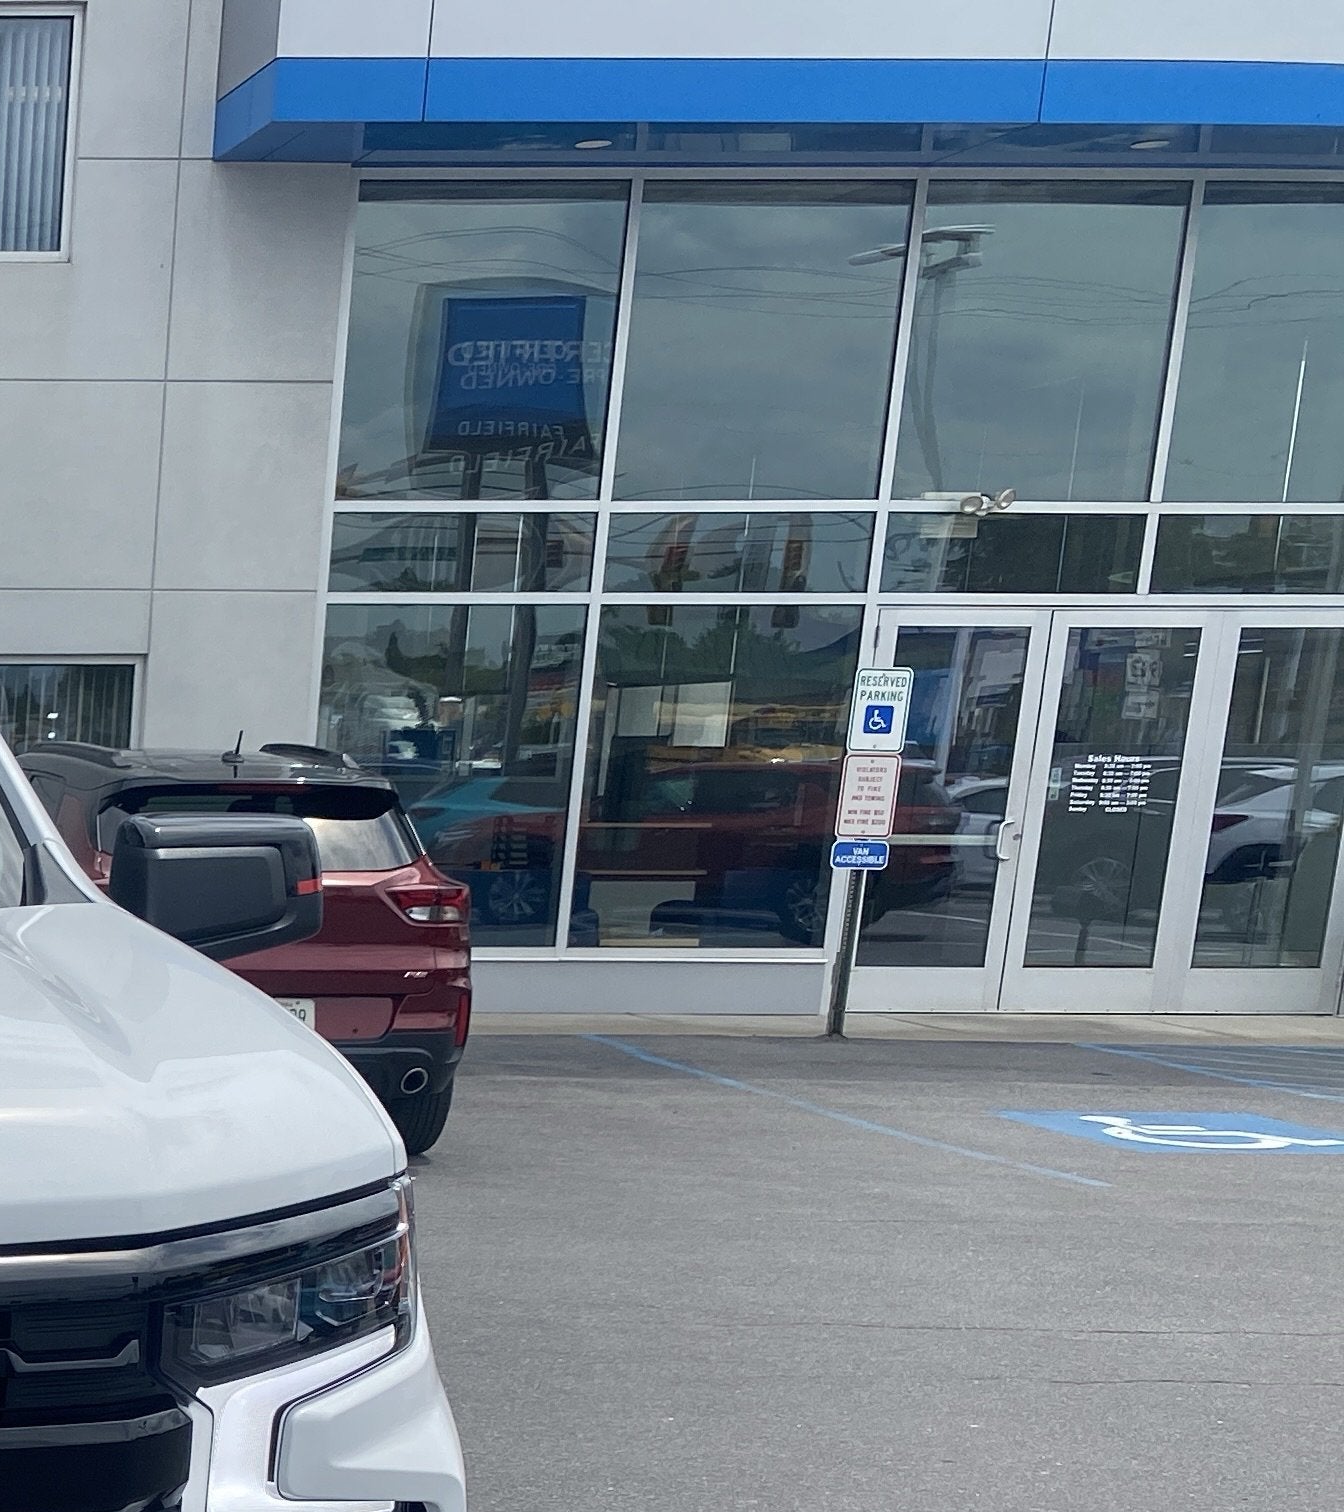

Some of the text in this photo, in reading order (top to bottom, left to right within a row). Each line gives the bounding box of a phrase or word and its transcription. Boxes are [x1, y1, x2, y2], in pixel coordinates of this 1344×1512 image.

[860, 675, 907, 687] RESERVED
[860, 690, 903, 701] PARKING
[1088, 754, 1140, 763] Sales Hours
[852, 847, 870, 856] VAN
[834, 855, 885, 864] ACCESSIBLE
